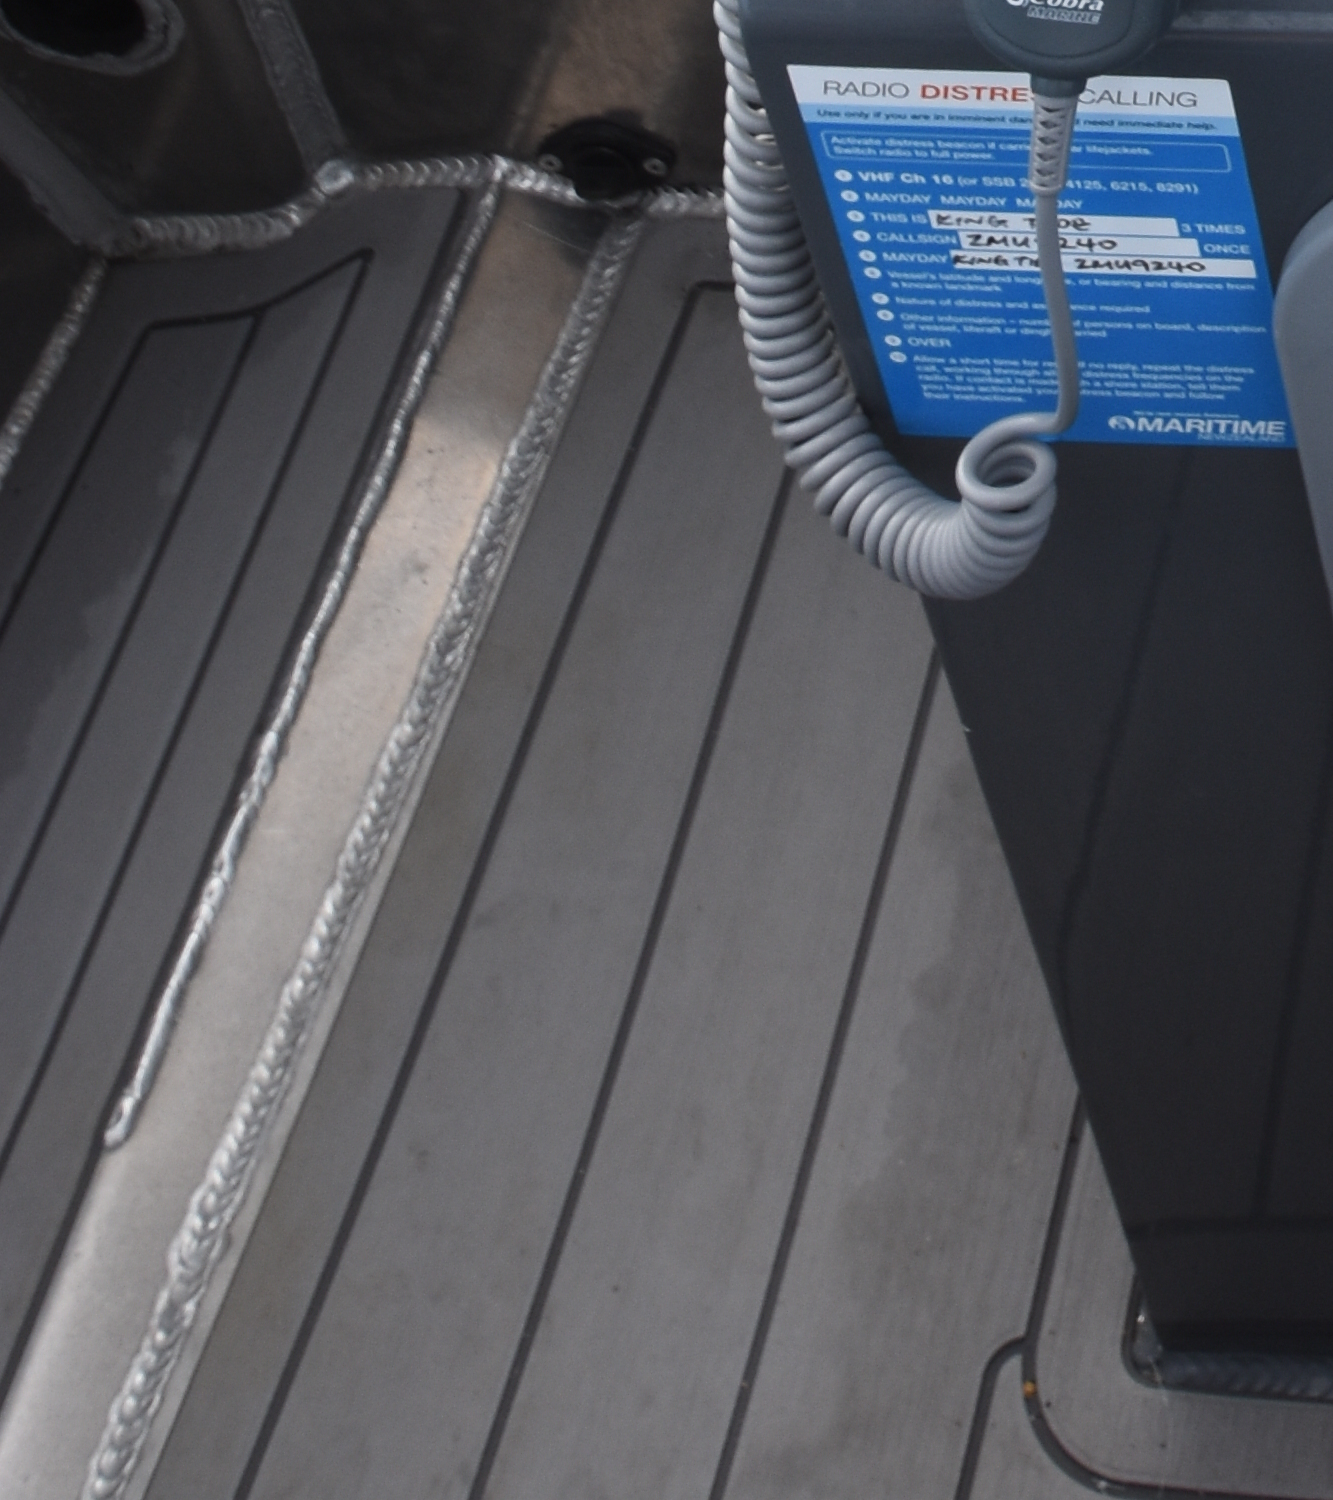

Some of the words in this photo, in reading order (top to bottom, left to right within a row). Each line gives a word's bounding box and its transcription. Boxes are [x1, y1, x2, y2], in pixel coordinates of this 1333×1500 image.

[1027, 5, 1101, 25] MARINE
[823, 80, 910, 99] RADIO
[920, 84, 1036, 103] DISTRE
[1079, 88, 1197, 108] CALLING
[817, 108, 841, 119] Use
[844, 110, 870, 121] only
[882, 113, 907, 123] you
[910, 113, 930, 122] are
[948, 114, 1006, 124] imminent
[1086, 118, 1115, 128] need
[1117, 119, 1184, 130] immediate
[831, 135, 883, 147] Activate
[884, 137, 935, 148] distress
[937, 139, 984, 150] beacon
[857, 170, 893, 182] VHF
[900, 172, 926, 184] Ch
[933, 174, 953, 185] 16
[957, 175, 978, 187] (or
[982, 176, 1016, 188] SSB
[864, 192, 931, 204] MAYDAY
[940, 194, 1006, 206] MAYDAY
[870, 211, 908, 223] THIS
[911, 213, 928, 223] IS
[936, 213, 1009, 228] KING
[1181, 223, 1192, 233] 3
[1196, 224, 1246, 235] TIMES
[876, 232, 958, 244] CALLSIGN
[966, 233, 1118, 253] ZMU240
[1203, 243, 1250, 255] ONCE
[882, 252, 949, 264] MAYDAY
[908, 337, 952, 348] OVER
[1137, 417, 1286, 436] MARITIME
